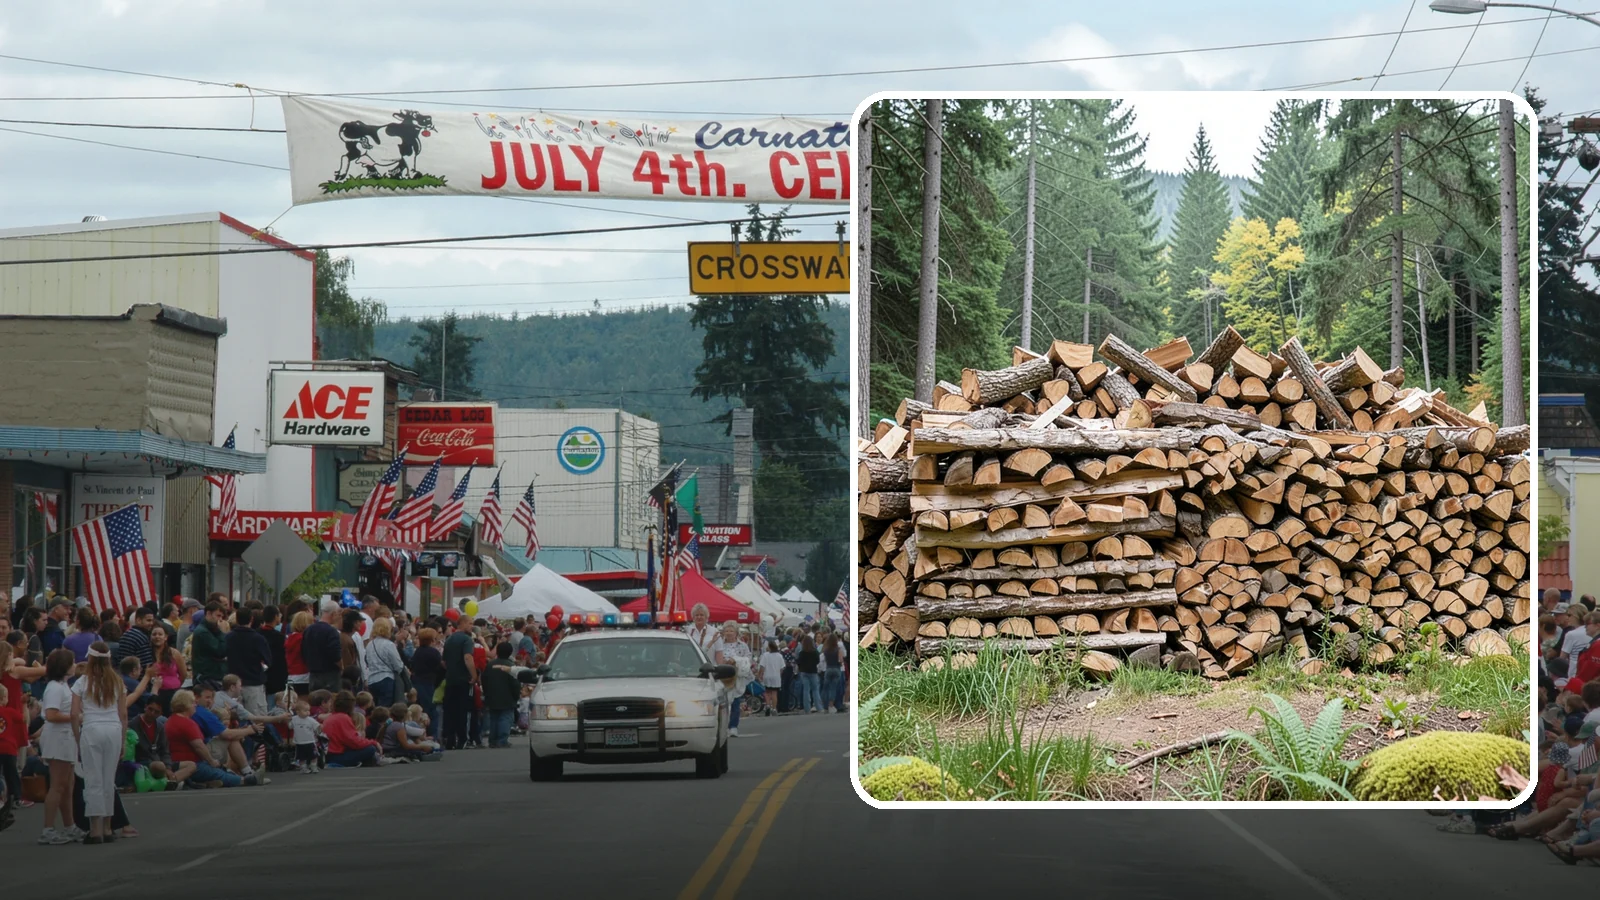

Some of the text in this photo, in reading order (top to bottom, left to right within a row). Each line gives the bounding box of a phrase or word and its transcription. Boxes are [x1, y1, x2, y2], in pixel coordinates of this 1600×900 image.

[481, 141, 605, 193] JULY
[632, 150, 746, 197] 4th.
[697, 254, 850, 280] CROSSWA
[283, 380, 374, 420] ACE
[405, 409, 453, 422] CEDAR
[283, 421, 371, 436] Hardware
[416, 428, 478, 447] Coca-Cola
[354, 467, 385, 480] Simpl
[83, 485, 155, 495] St. Vincent de Paul
[688, 526, 741, 535] CRNATION
[700, 535, 730, 543] GLASS
